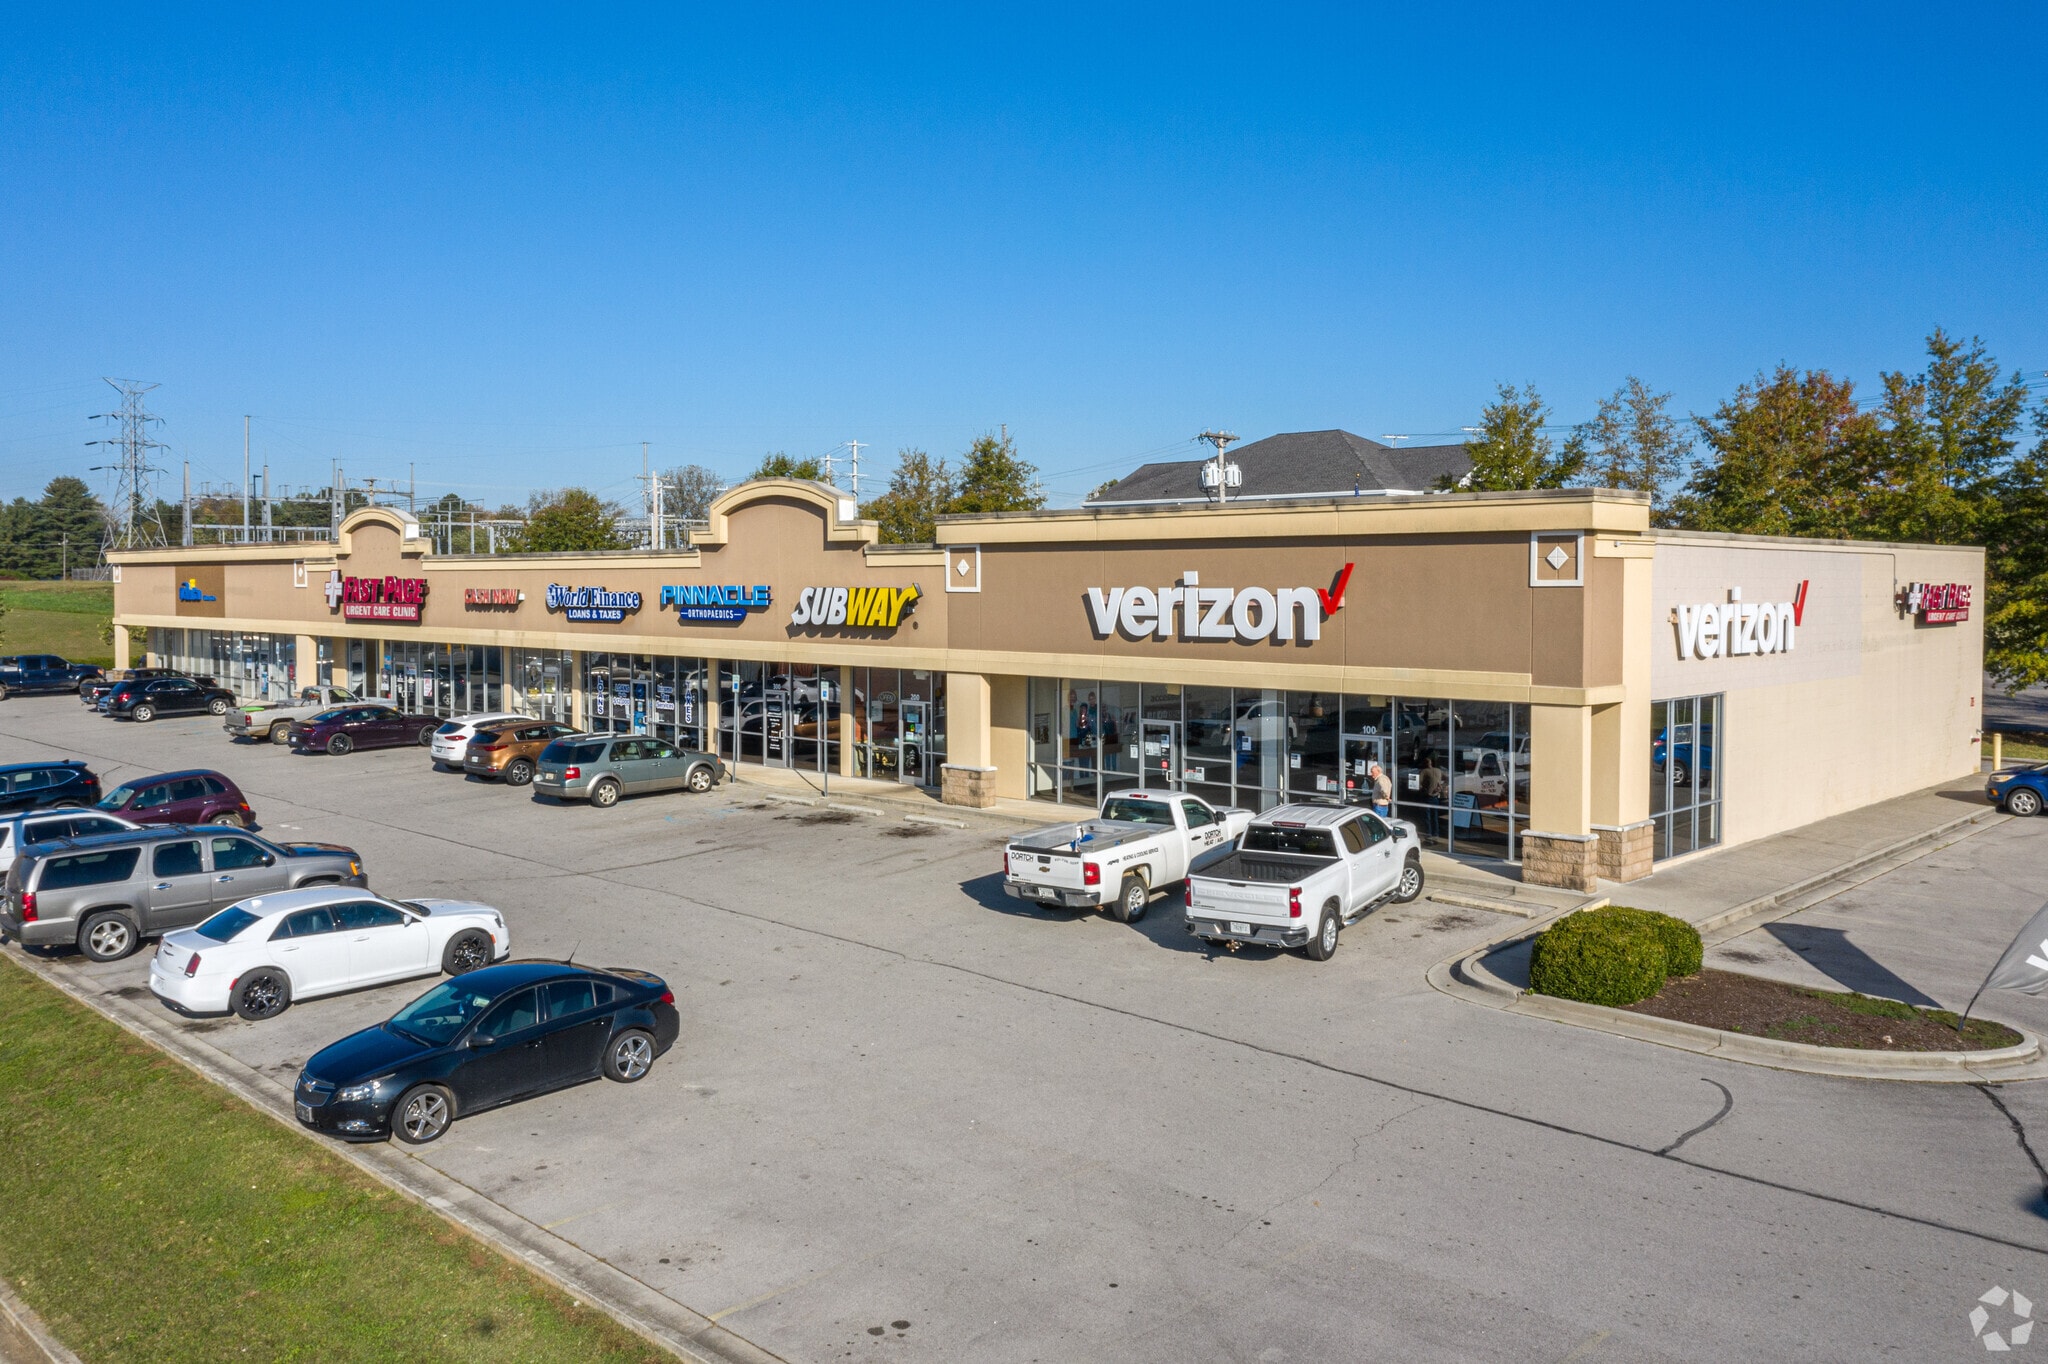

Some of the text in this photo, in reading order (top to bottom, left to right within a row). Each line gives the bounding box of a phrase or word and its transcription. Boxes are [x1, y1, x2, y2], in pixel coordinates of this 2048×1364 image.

[343, 575, 425, 603] FAST PACE
[465, 588, 517, 605] CASH NOW
[554, 585, 640, 609] World Finance
[661, 585, 770, 605] PINNACLE
[346, 604, 416, 618] URGENT CARE CLINIC
[568, 609, 622, 620] LOANS & TAXES
[687, 609, 735, 620] ORTHOPAEDICS
[791, 583, 924, 627] SUBWAY
[1088, 571, 1321, 641] verizon
[1677, 586, 1795, 658] verizon
[596, 675, 605, 715] LOANS
[685, 680, 693, 723] TAXES
[1362, 725, 1377, 735] 100
[1204, 829, 1221, 840] DORTCH
[1011, 852, 1034, 863] DORTCH
